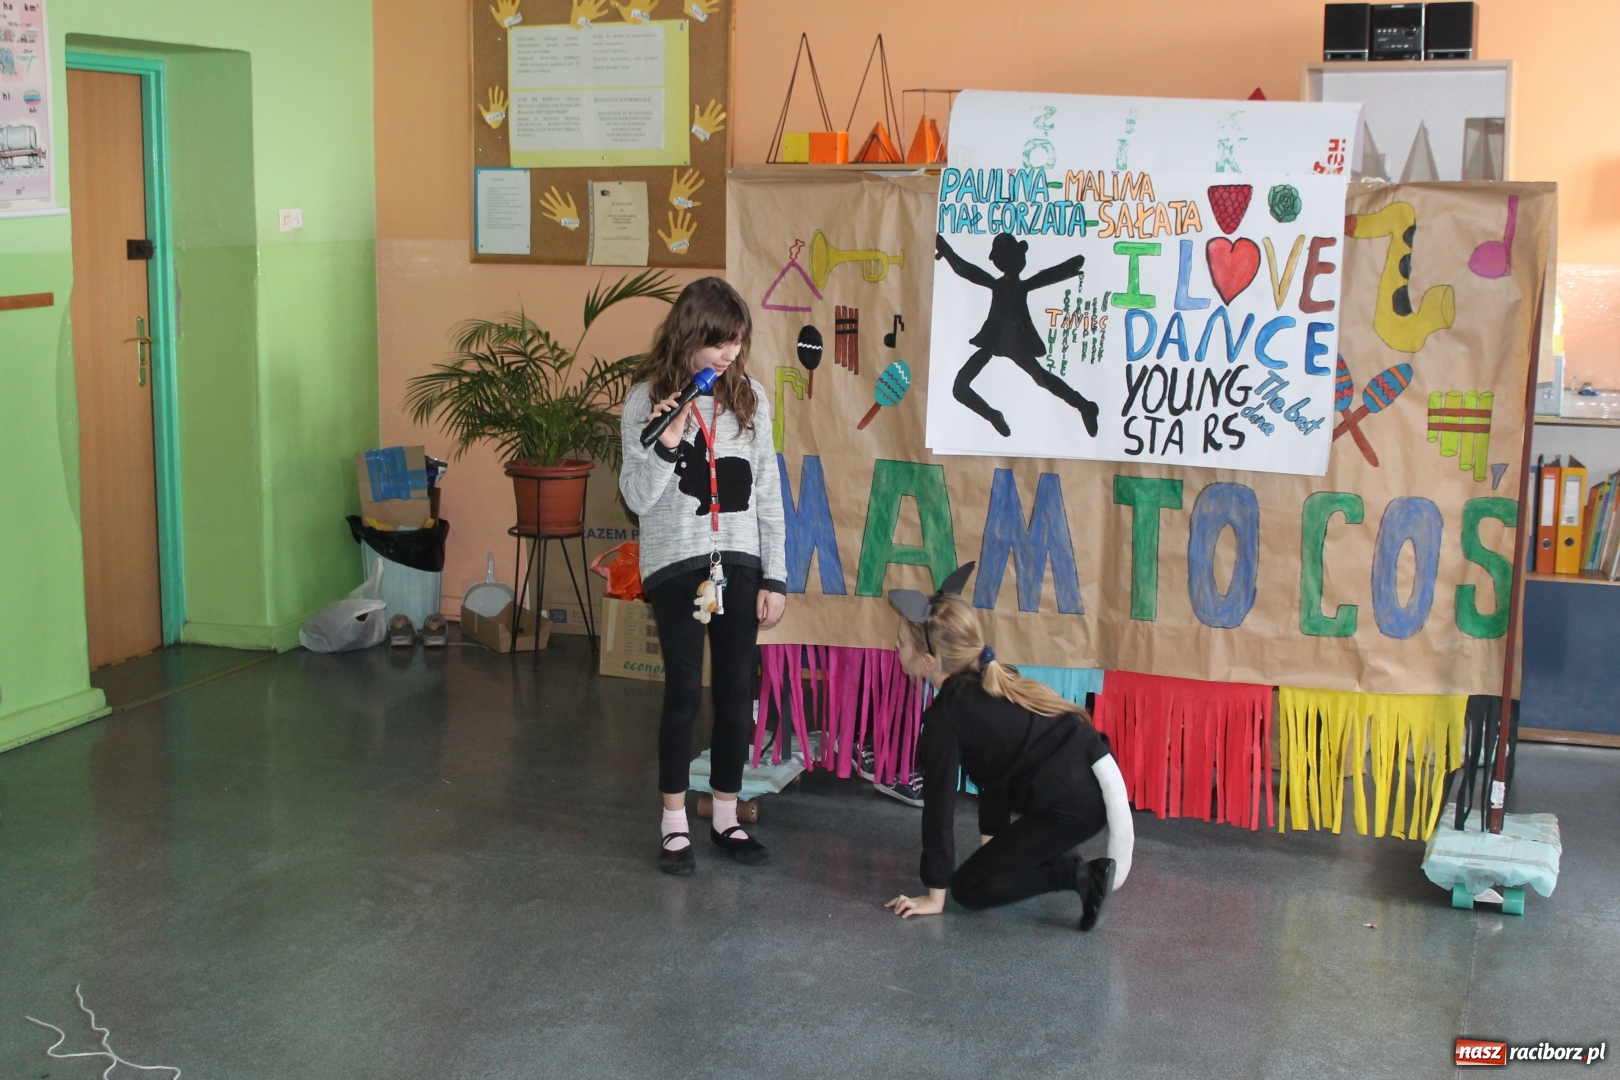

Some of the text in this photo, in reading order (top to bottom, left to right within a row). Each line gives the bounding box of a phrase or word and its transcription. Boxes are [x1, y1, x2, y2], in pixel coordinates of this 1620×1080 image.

[1111, 241, 1162, 309] I
[1125, 305, 1335, 376] DANCE
[1121, 364, 1253, 417] YOUNG
[1240, 402, 1275, 436] dance
[1254, 370, 1326, 436] The best
[1113, 474, 1261, 629] TO
